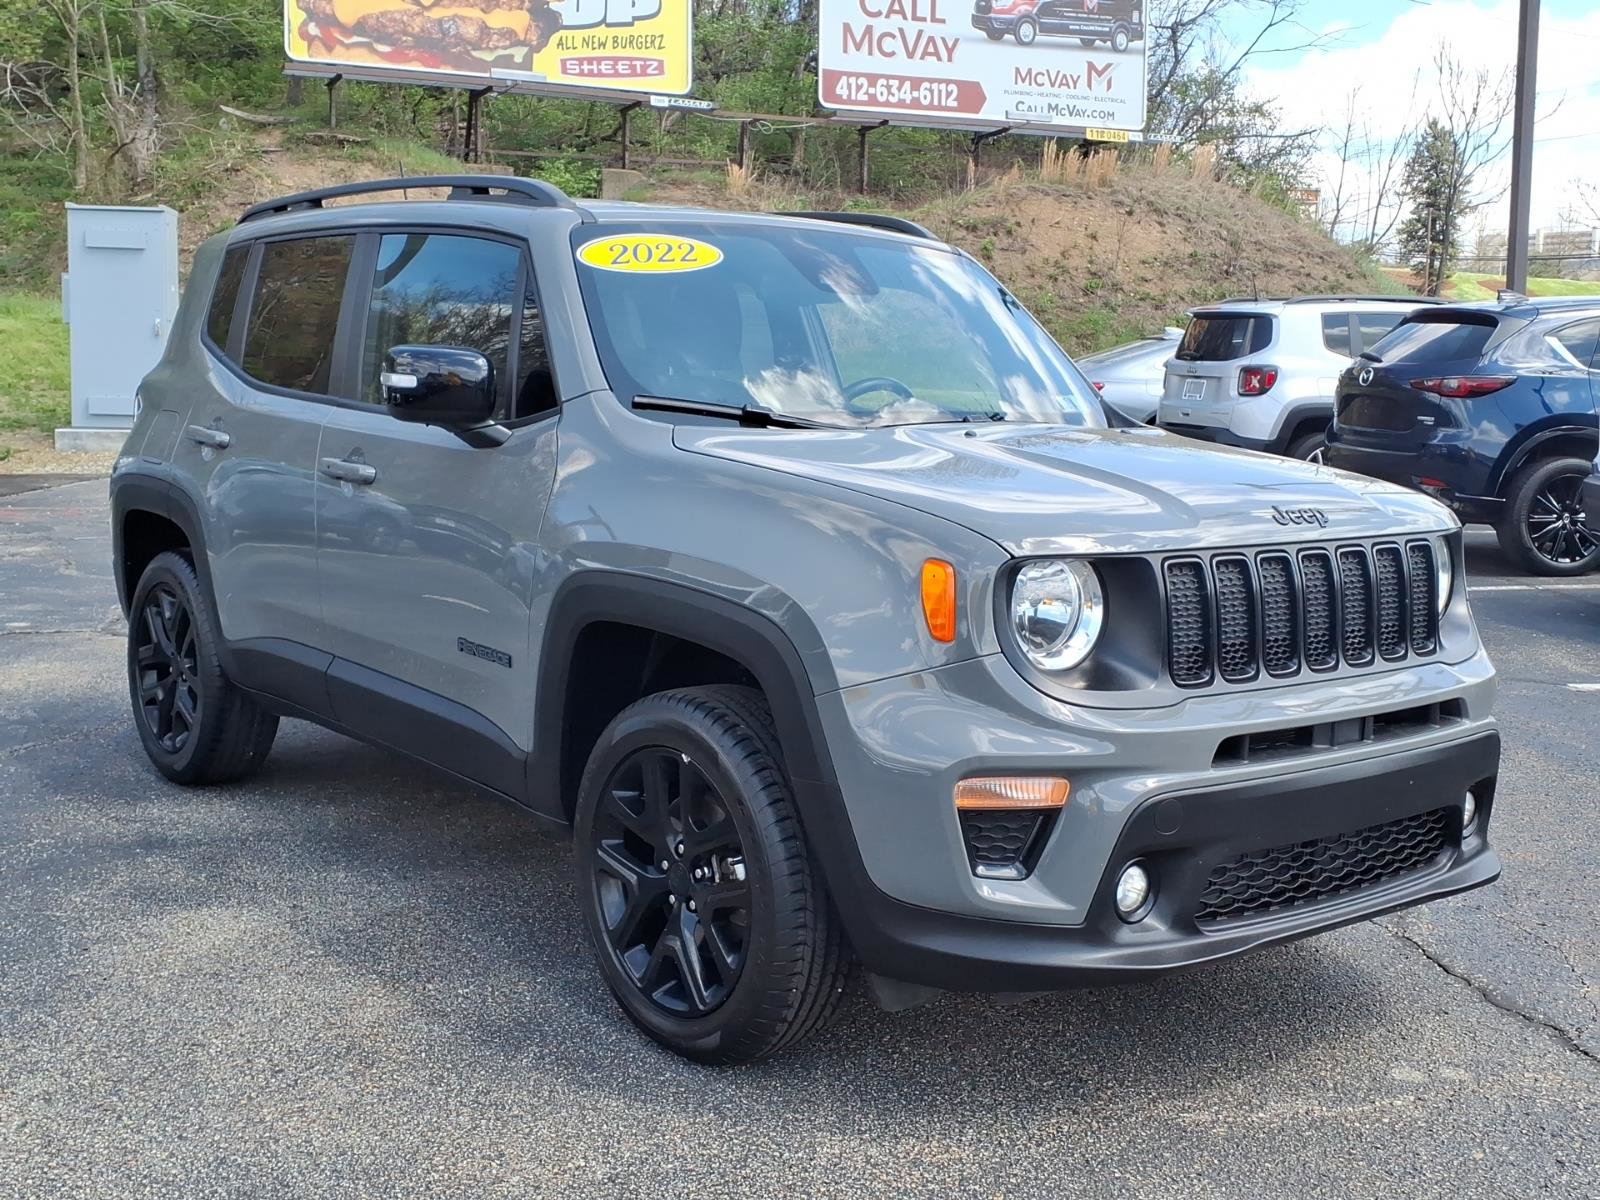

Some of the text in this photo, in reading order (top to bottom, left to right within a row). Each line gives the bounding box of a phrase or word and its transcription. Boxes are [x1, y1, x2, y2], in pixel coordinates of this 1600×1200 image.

[859, 0, 946, 24] CALL
[556, 34, 666, 51] ALL NEW BURGERZ
[566, 60, 660, 74] SHEETZ
[836, 76, 958, 107] 412-634-6112
[1003, 89, 1034, 97] PLUMBING
[1094, 96, 1127, 104] ELECTRICAL
[610, 242, 698, 265] 2022
[1272, 505, 1329, 528] Jeep
[457, 637, 512, 668] RENEGADE
